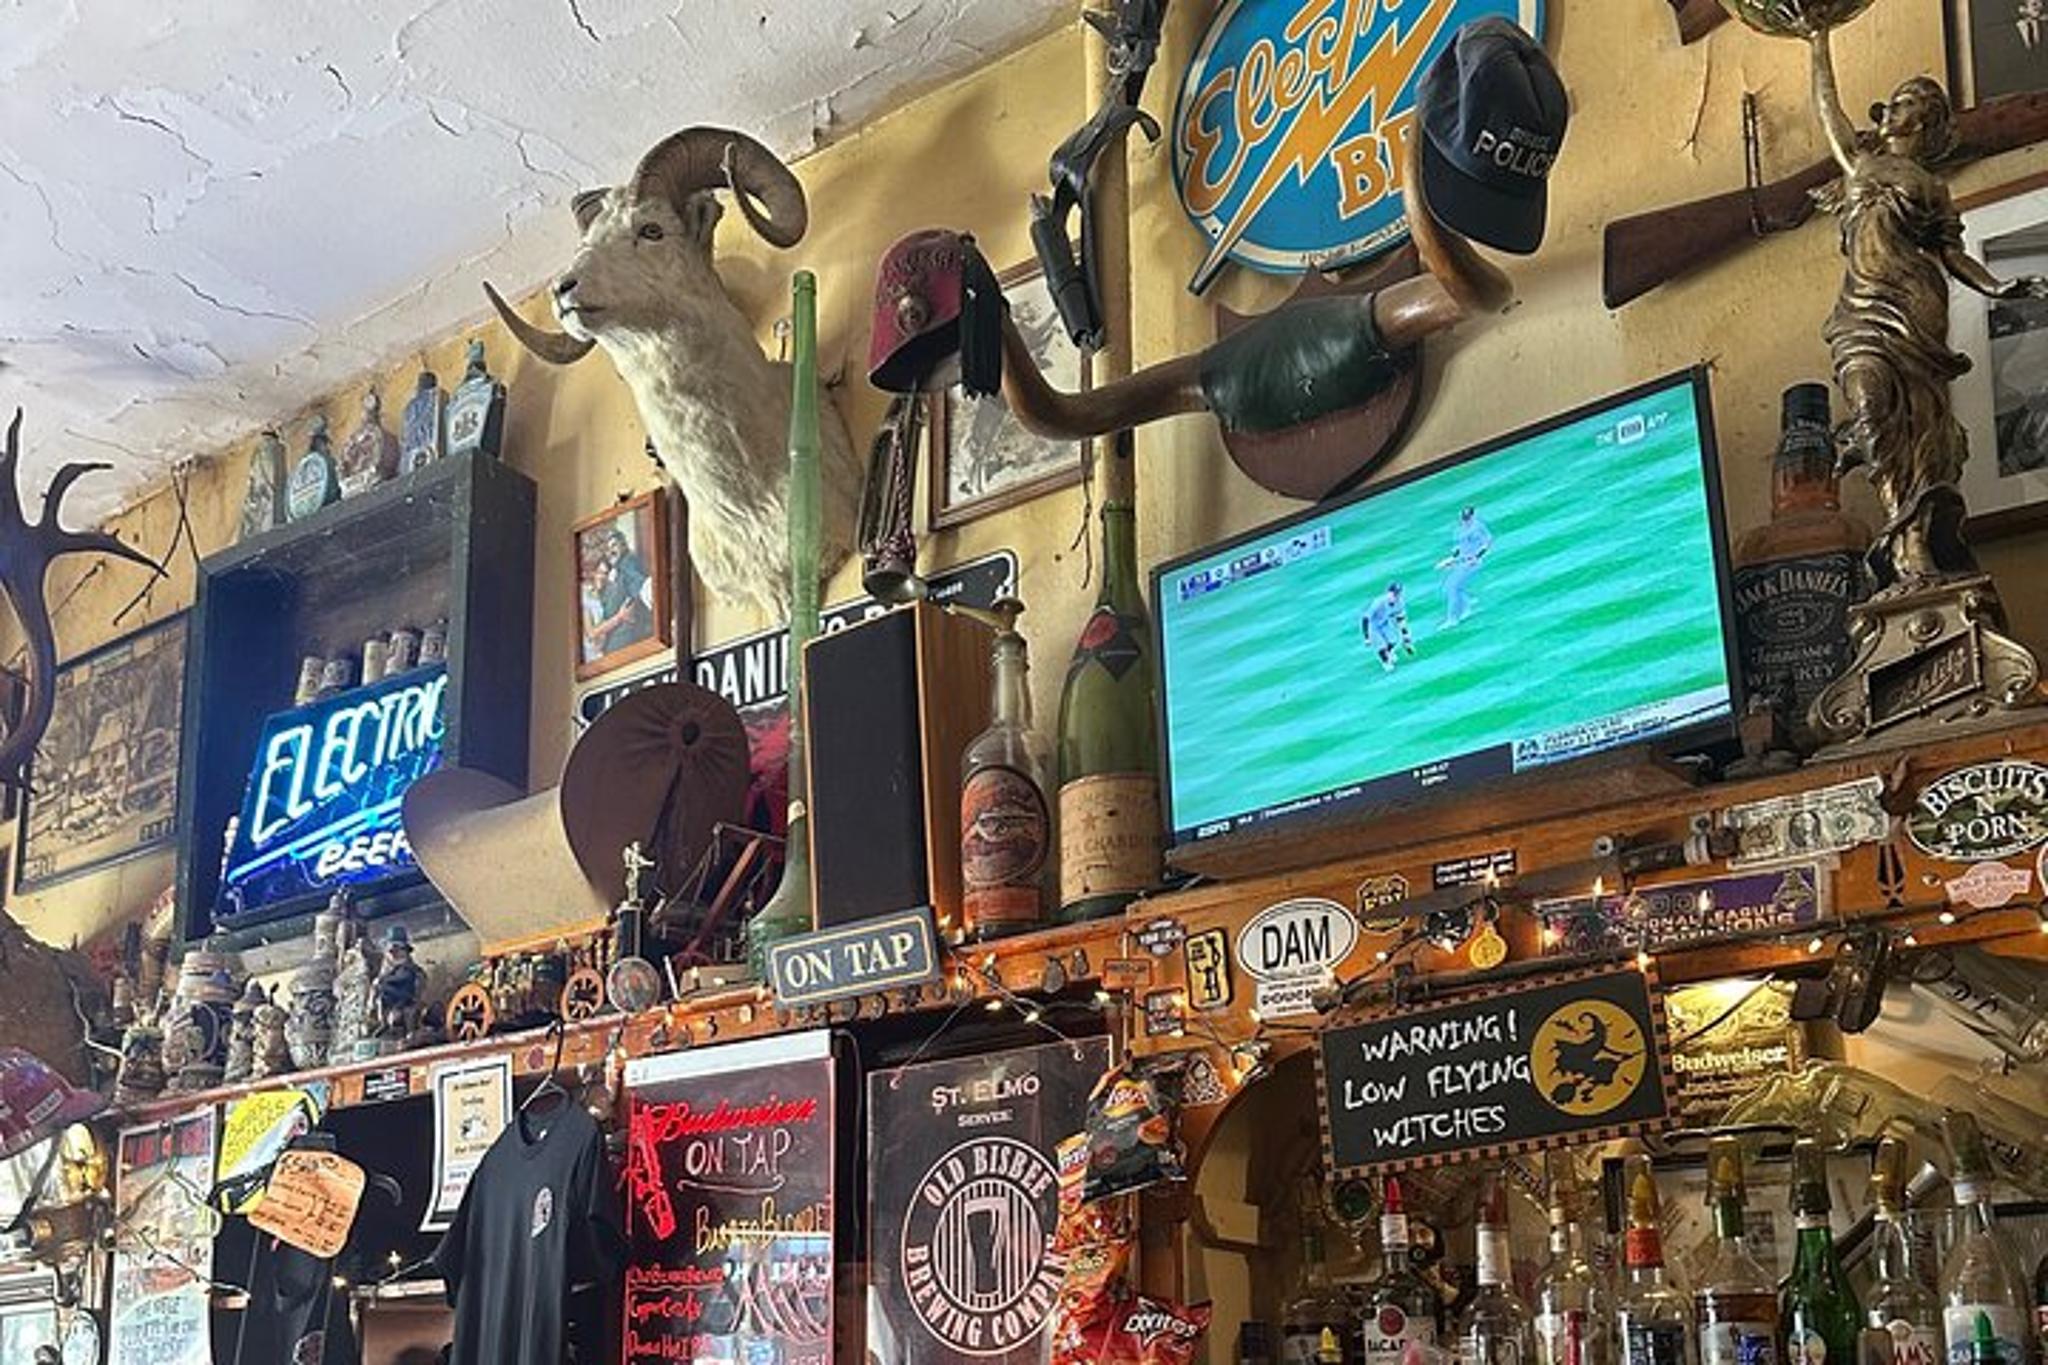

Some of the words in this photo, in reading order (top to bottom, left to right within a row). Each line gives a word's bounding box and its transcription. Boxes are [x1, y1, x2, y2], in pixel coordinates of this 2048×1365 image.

[251, 673, 449, 843] ELECTRIC
[1921, 767, 2048, 818] BISCUITS
[1945, 809, 2028, 846] PORN
[785, 949, 834, 988] ON
[844, 932, 914, 977] TAP
[1261, 916, 1332, 970] DAM
[932, 1085, 966, 1112] ST.
[974, 1075, 1040, 1102] ELMO
[1344, 1075, 1407, 1110] LOW
[1426, 1054, 1532, 1099] FLYING
[685, 1137, 723, 1176] ON
[731, 1128, 791, 1176] TAP
[1372, 1105, 1507, 1148] WITCHES
[923, 1156, 966, 1207] OLD
[973, 1145, 1053, 1200] BISBEE
[906, 1244, 983, 1348] BREWING
